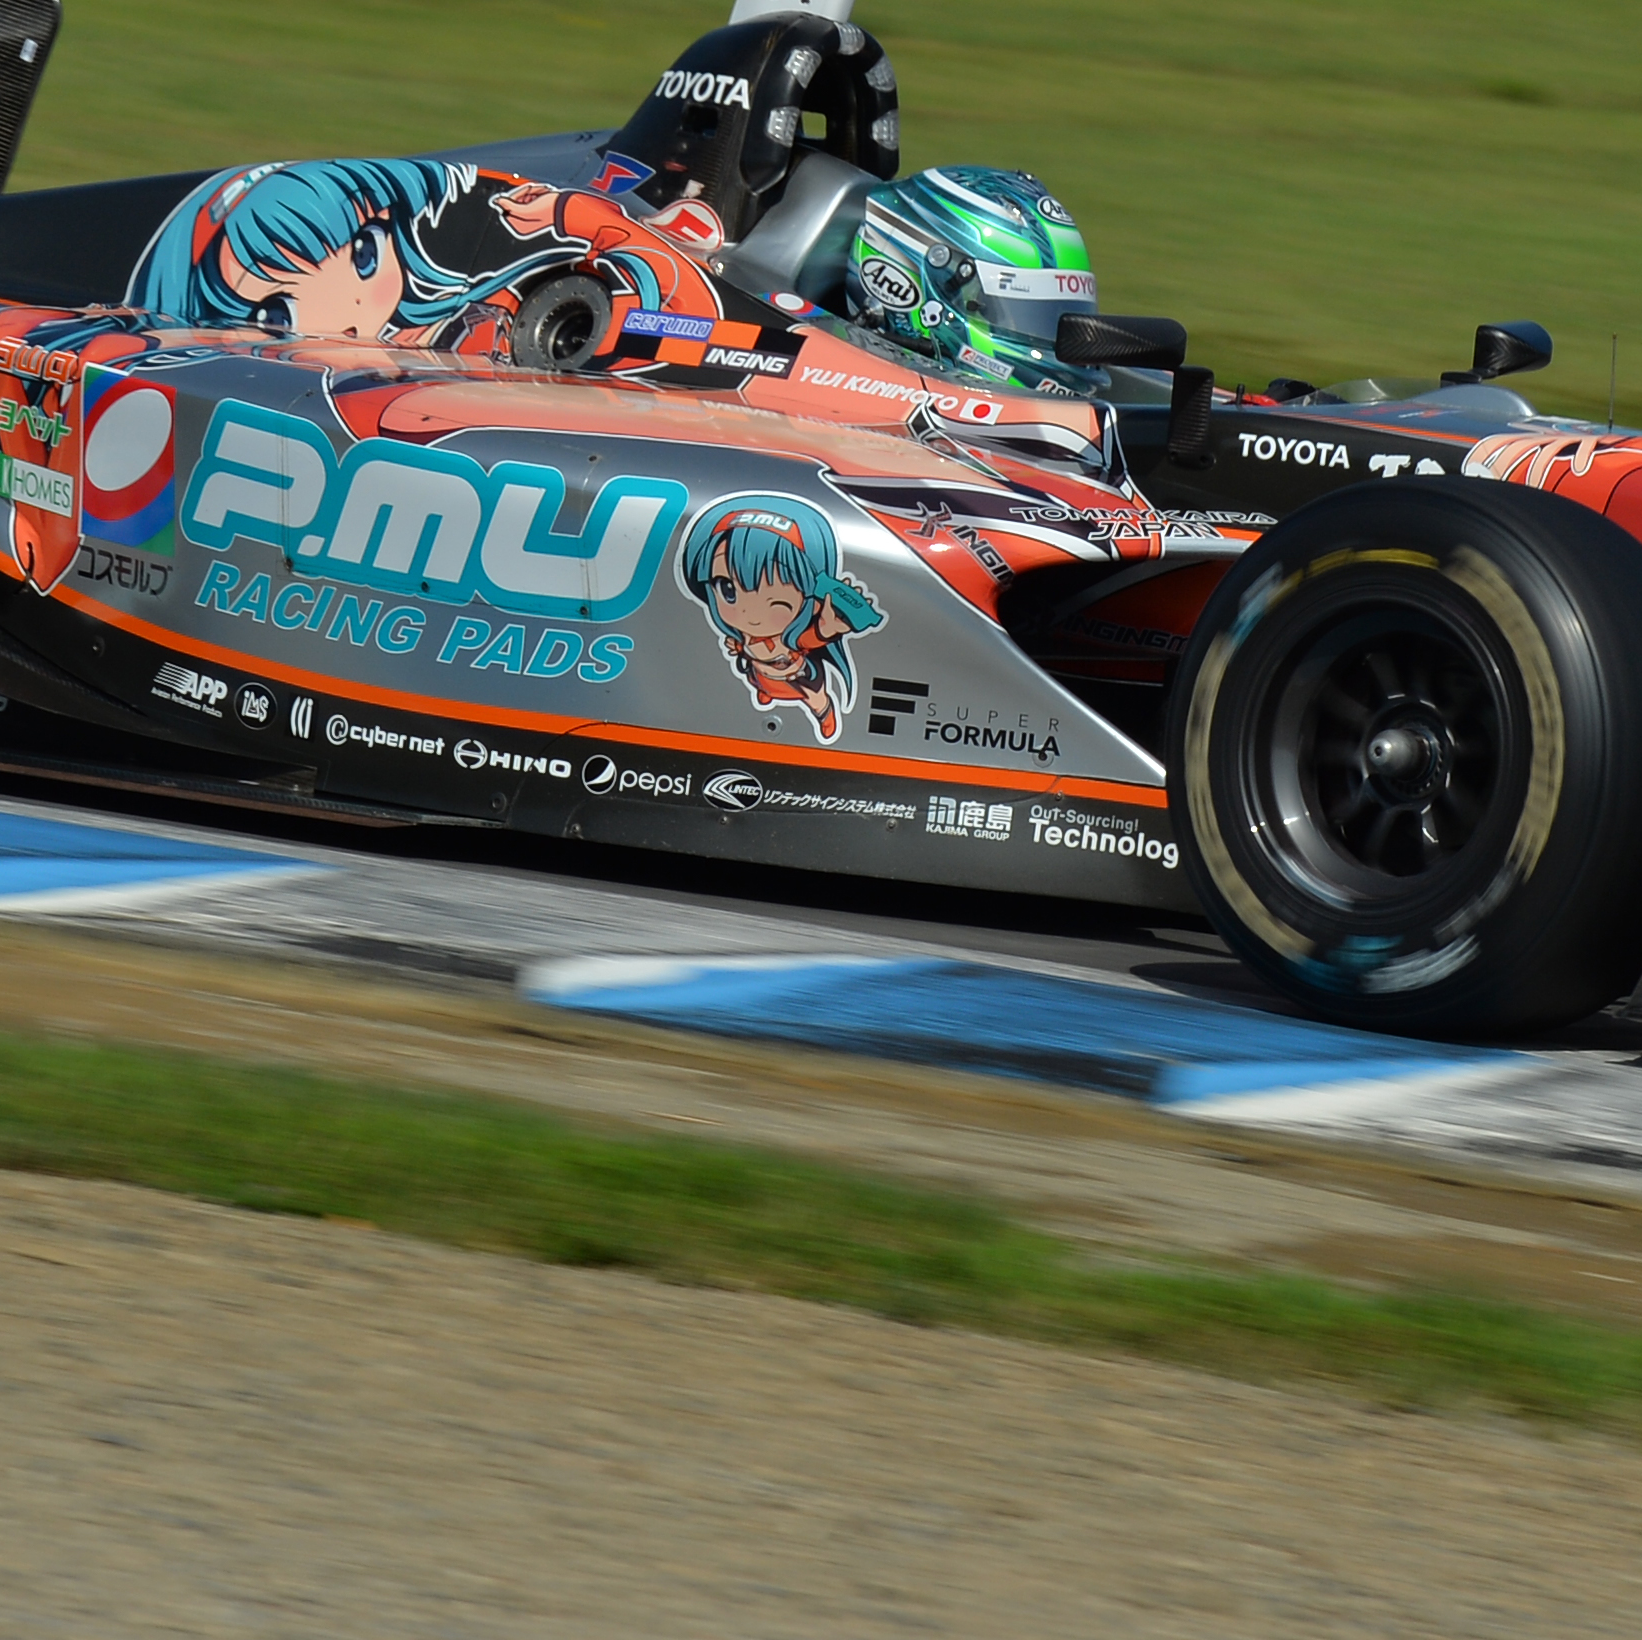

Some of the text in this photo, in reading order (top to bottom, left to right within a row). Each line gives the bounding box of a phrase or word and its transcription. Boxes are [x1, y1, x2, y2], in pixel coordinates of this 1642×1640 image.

[655, 69, 751, 111] TOYOTA
[863, 263, 914, 302] Arai
[705, 347, 790, 373] INGING
[799, 366, 959, 411] YUJI KUNIMOTO
[1238, 432, 1351, 470] TOYOTA
[14, 470, 71, 510] HOMES
[1009, 506, 1279, 525] TOMMYKAIRA
[1087, 521, 1225, 540] JAPAN
[195, 559, 635, 683] RACING PADS
[179, 671, 228, 705] APP
[927, 702, 1060, 732] SUPER
[924, 720, 1061, 757] FORMULA
[489, 750, 572, 779] HINO
[619, 769, 692, 797] pepsi
[728, 784, 761, 797] LINTEC
[925, 822, 1010, 842] KAJIMA GROUP
